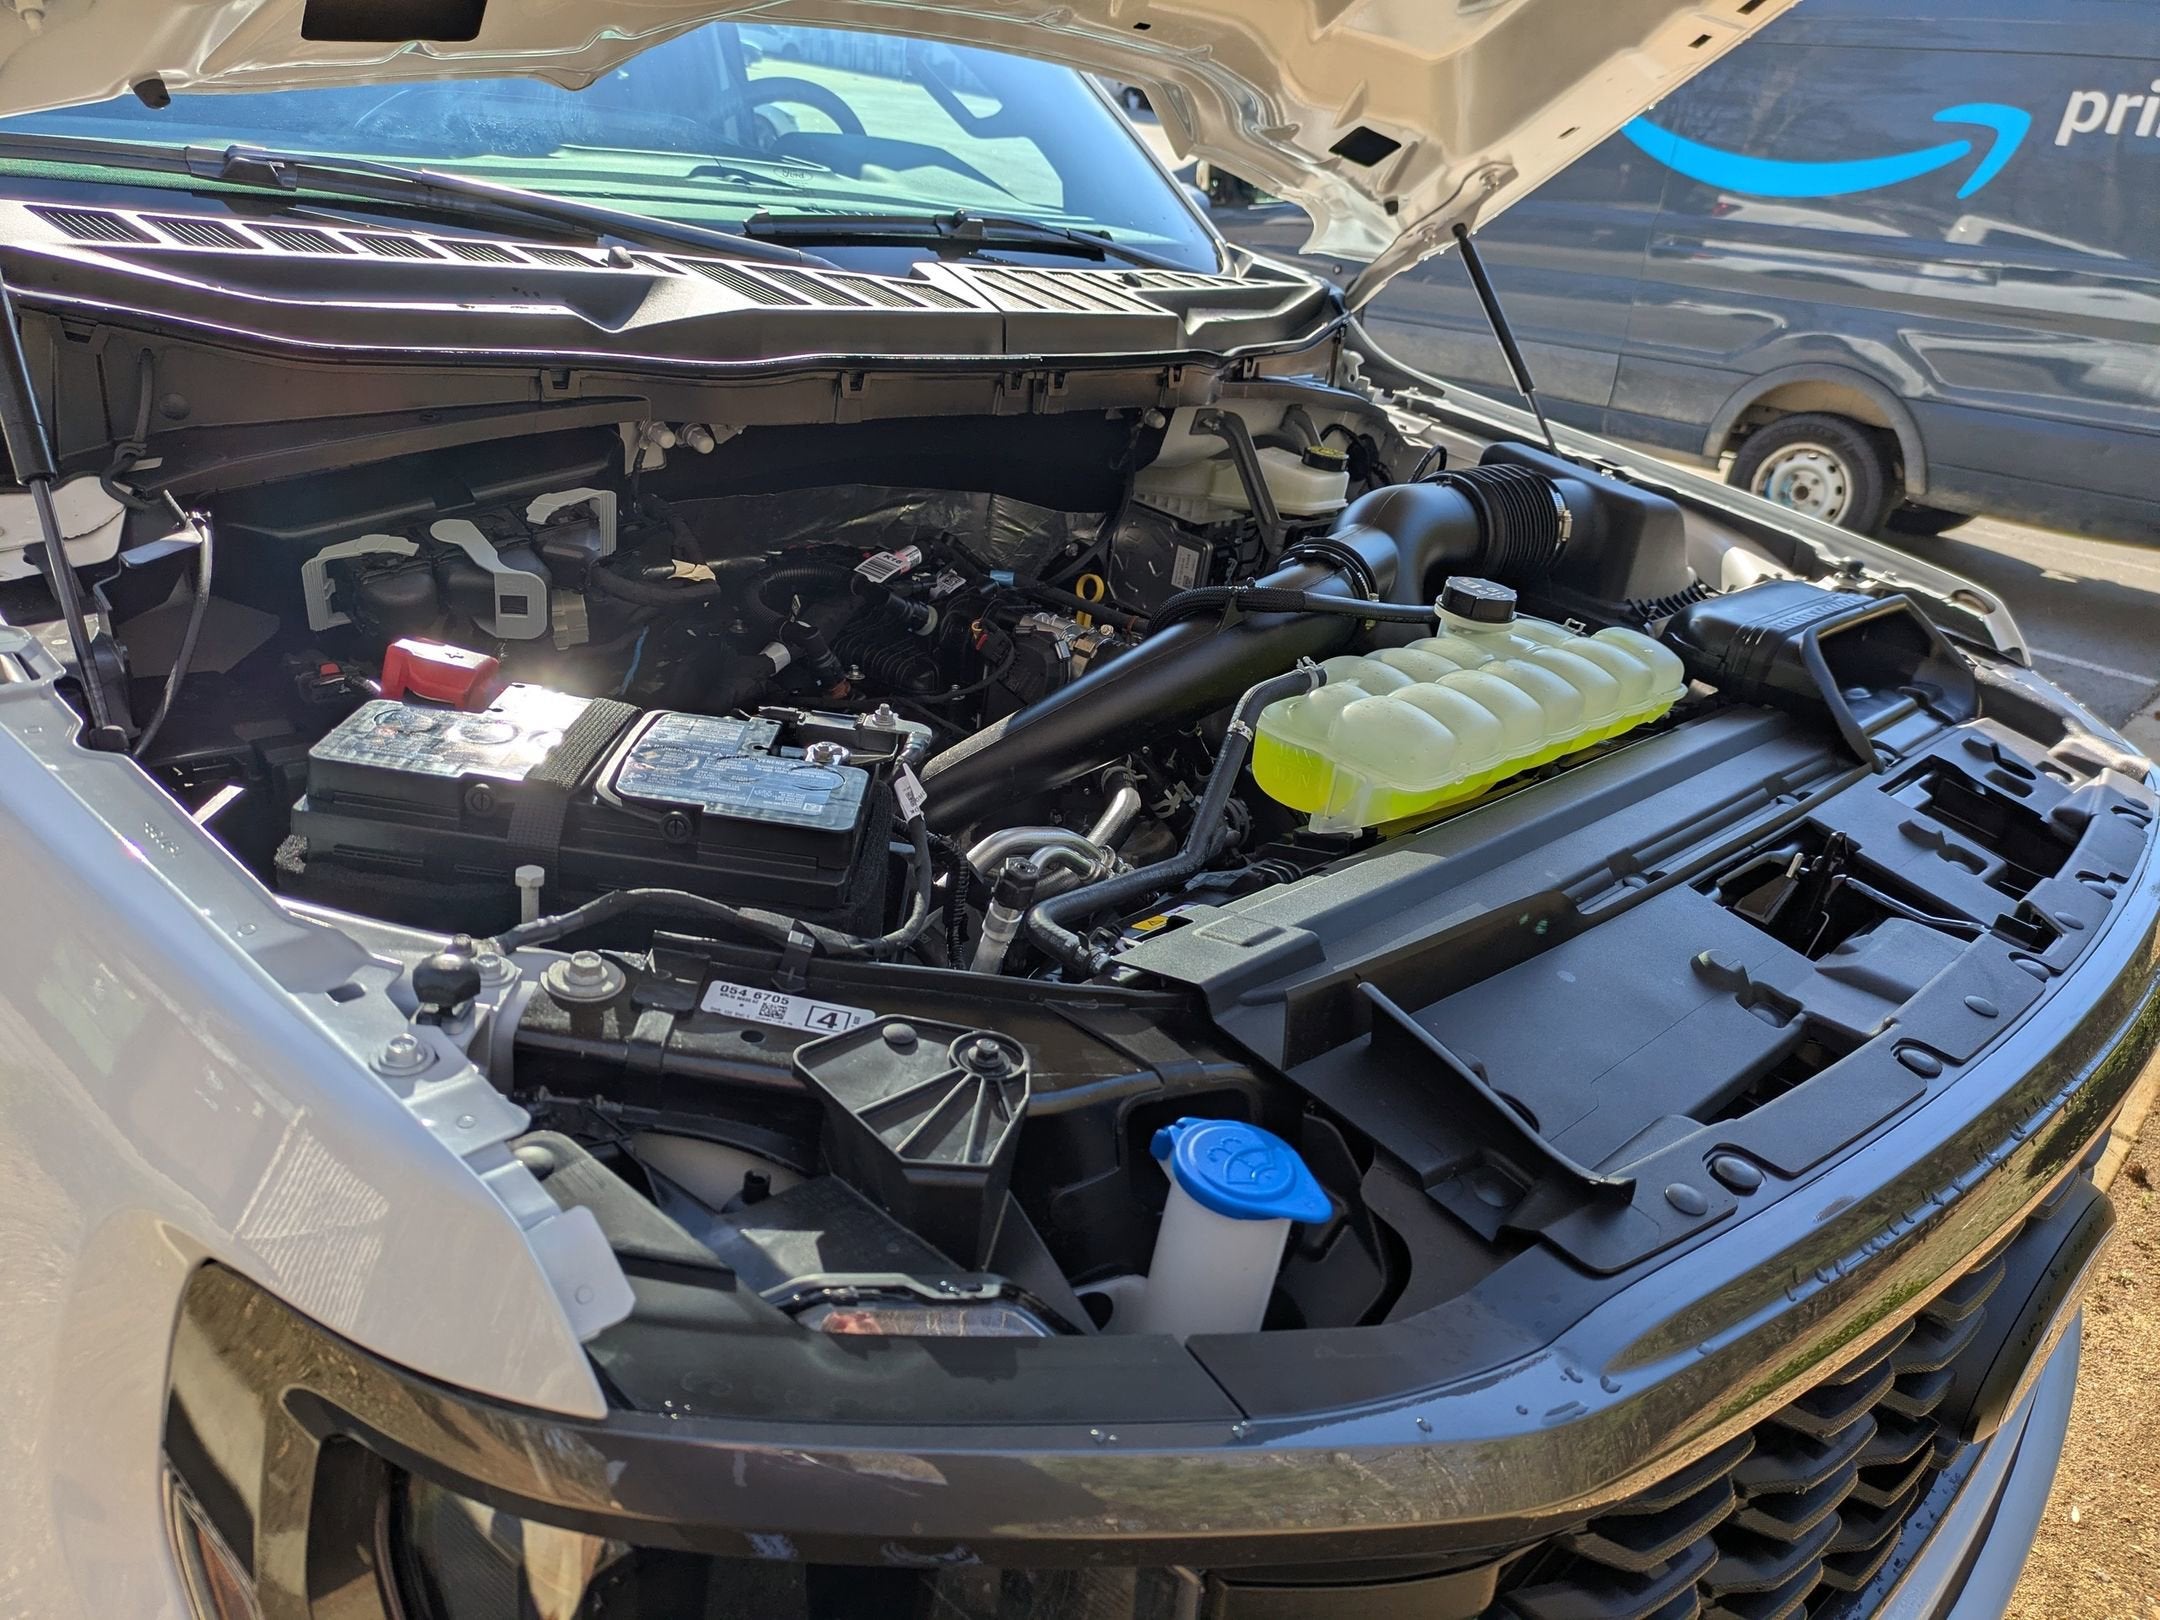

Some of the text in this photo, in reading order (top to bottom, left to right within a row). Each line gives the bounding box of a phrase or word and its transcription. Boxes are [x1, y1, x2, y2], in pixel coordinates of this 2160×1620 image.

[2054, 79, 2160, 147] pri
[720, 984, 748, 997] 054
[753, 991, 790, 1005] 6705
[816, 1011, 838, 1029] 4
